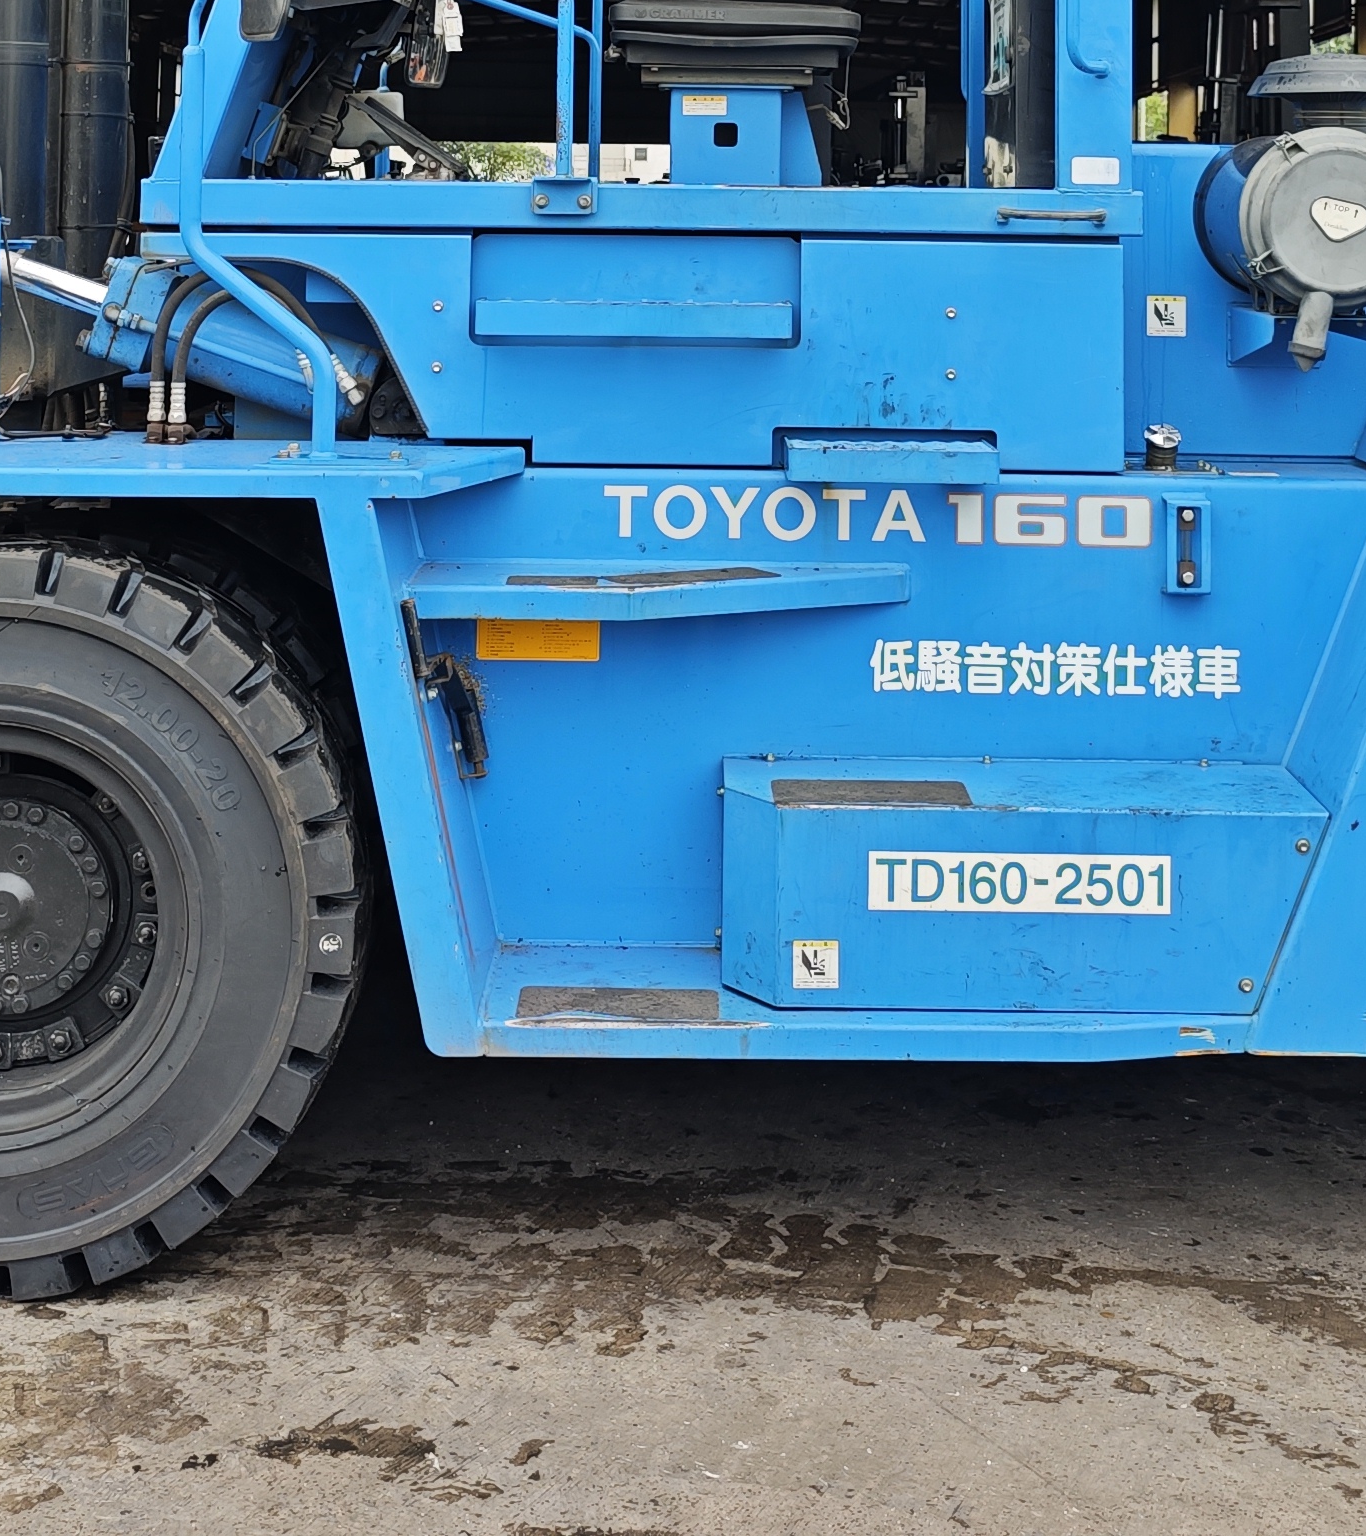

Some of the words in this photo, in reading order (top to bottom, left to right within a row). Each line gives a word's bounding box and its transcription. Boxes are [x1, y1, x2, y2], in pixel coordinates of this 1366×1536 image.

[649, 8, 726, 21] GRAMMER
[1334, 204, 1350, 213] TOP
[603, 484, 926, 543] TOYOTA
[946, 494, 1152, 549] 160
[869, 638, 1242, 700] 低騒音対策仕様車
[99, 667, 239, 813] 12.00-20
[875, 857, 1168, 908] TD160-2501
